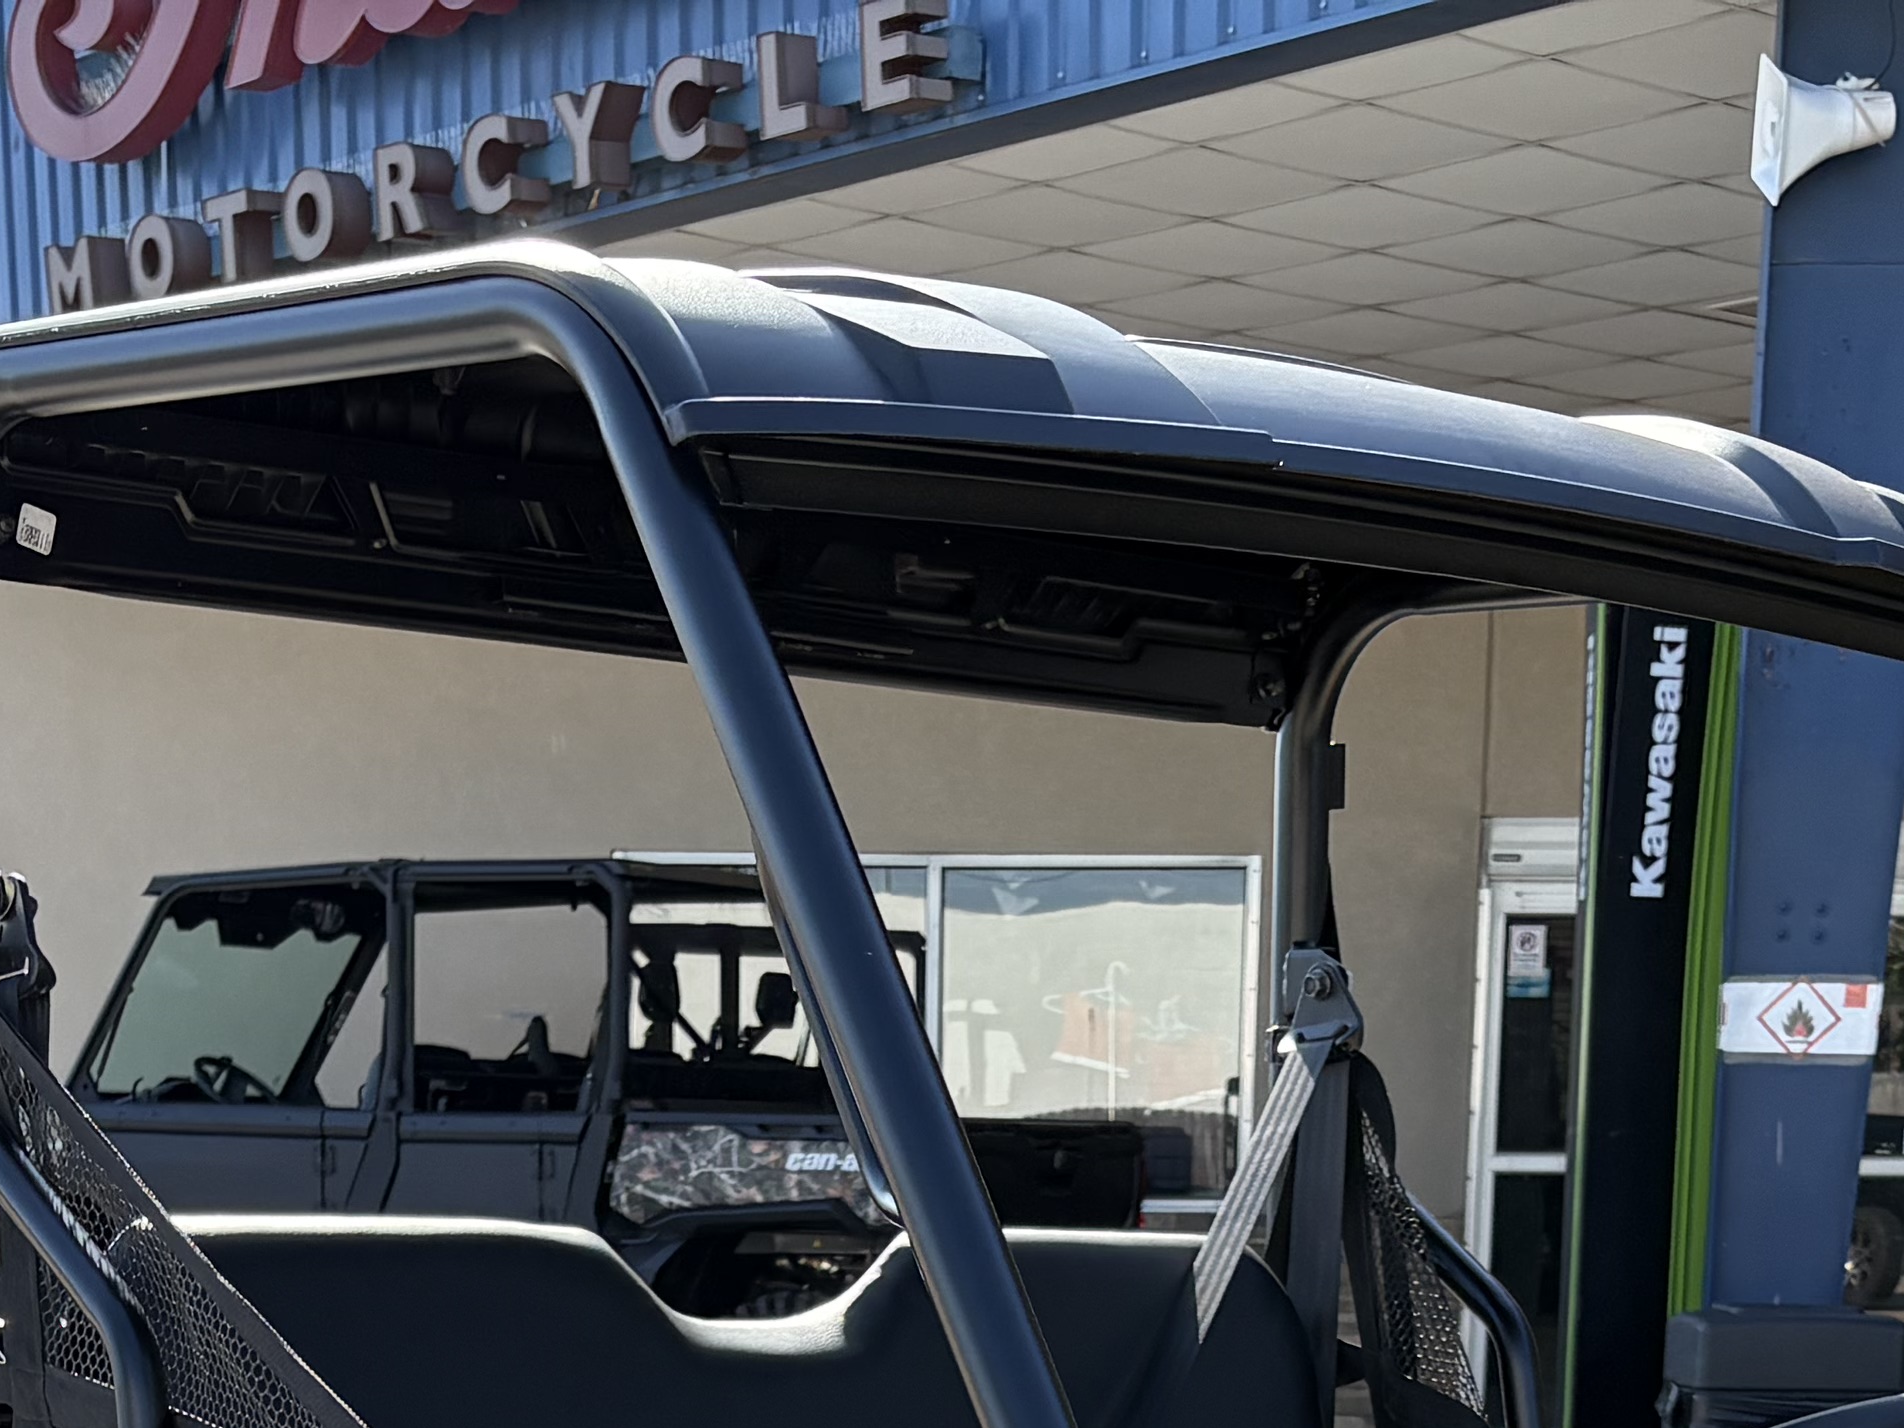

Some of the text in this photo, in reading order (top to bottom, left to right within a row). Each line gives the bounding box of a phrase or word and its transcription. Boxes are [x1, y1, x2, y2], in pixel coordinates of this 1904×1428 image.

[44, 0, 954, 314] MOTORCYCLE
[1629, 625, 1688, 898] Kawasaki
[785, 1153, 860, 1171] can-a
